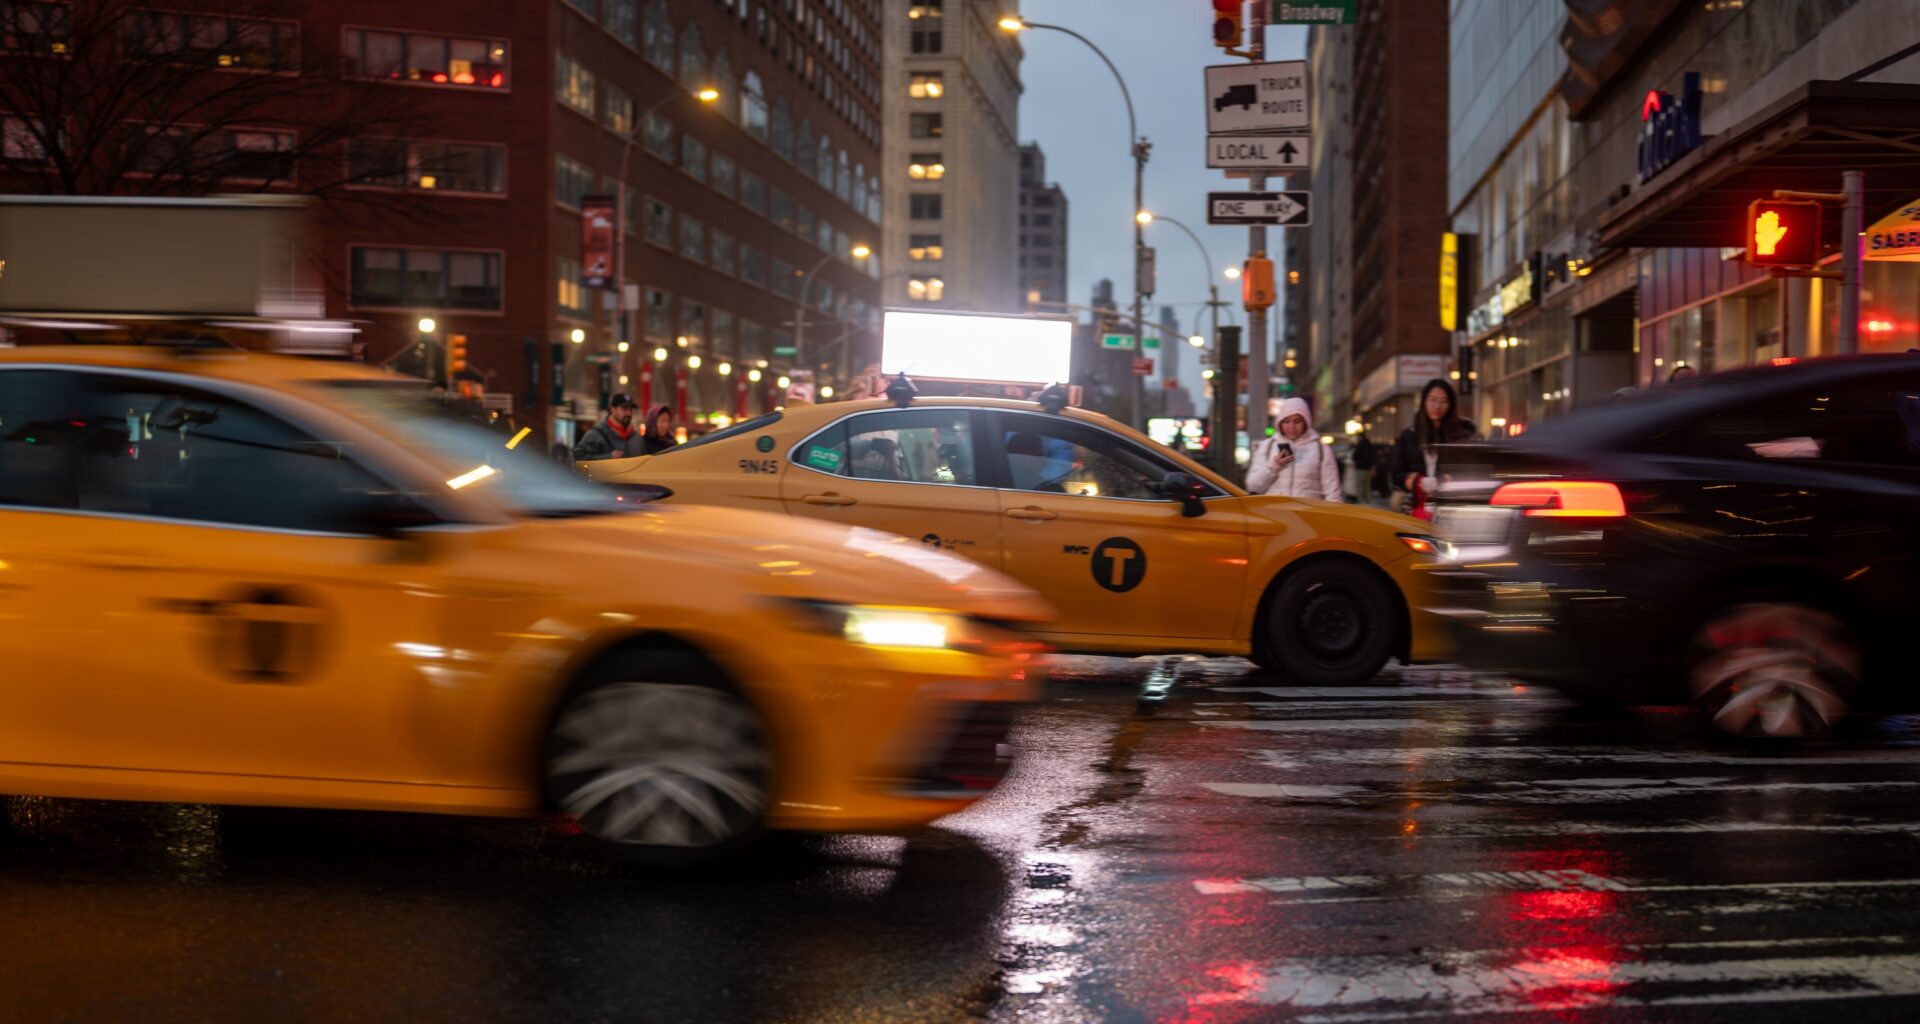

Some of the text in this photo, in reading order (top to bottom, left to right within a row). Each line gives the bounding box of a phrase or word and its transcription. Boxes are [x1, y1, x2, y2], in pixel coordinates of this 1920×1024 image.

[1280, 3, 1345, 24] Broadway
[1261, 76, 1303, 91] TRUCK
[1262, 99, 1304, 114] ROUTE
[1216, 143, 1269, 160] LOCAL
[1218, 201, 1293, 215] ONE WAY
[739, 459, 778, 474] 9N45
[1063, 544, 1090, 555] NYC
